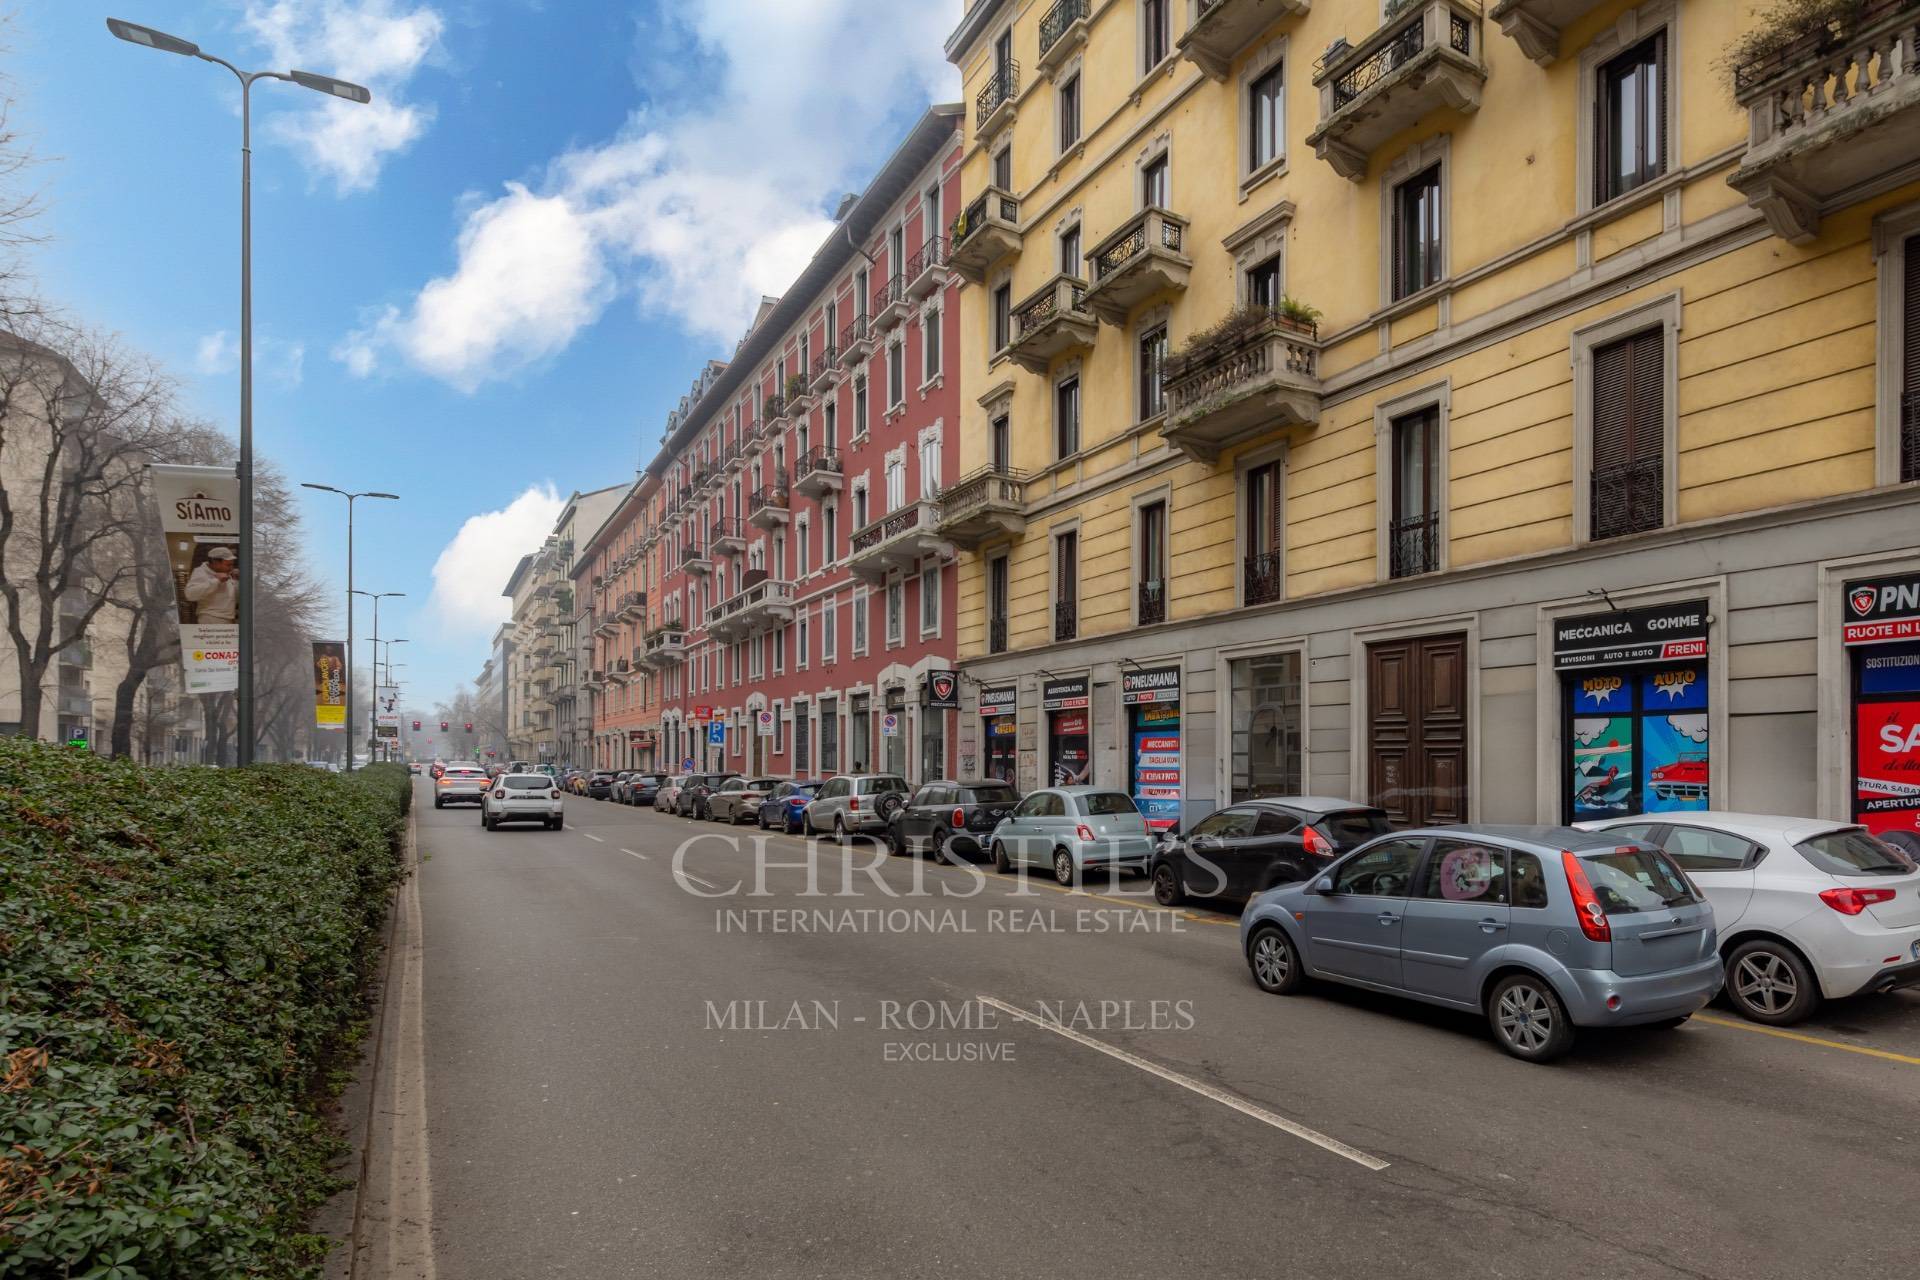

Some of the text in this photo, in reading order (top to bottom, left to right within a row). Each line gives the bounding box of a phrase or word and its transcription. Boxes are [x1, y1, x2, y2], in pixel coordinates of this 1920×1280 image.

[1880, 583, 1920, 612] PN
[1559, 615, 1699, 641] MECCANICA GOMME
[1847, 624, 1893, 639] RUOTE
[1897, 623, 1911, 634] IN
[1561, 655, 1595, 664] REVISIONI
[1603, 651, 1623, 660] AUTO
[1631, 649, 1653, 657] MOTO
[1668, 643, 1703, 655] FRENI
[1131, 672, 1178, 689] PNEUSMANIA
[1583, 676, 1622, 691] MOTO
[1654, 671, 1696, 686] AUTO
